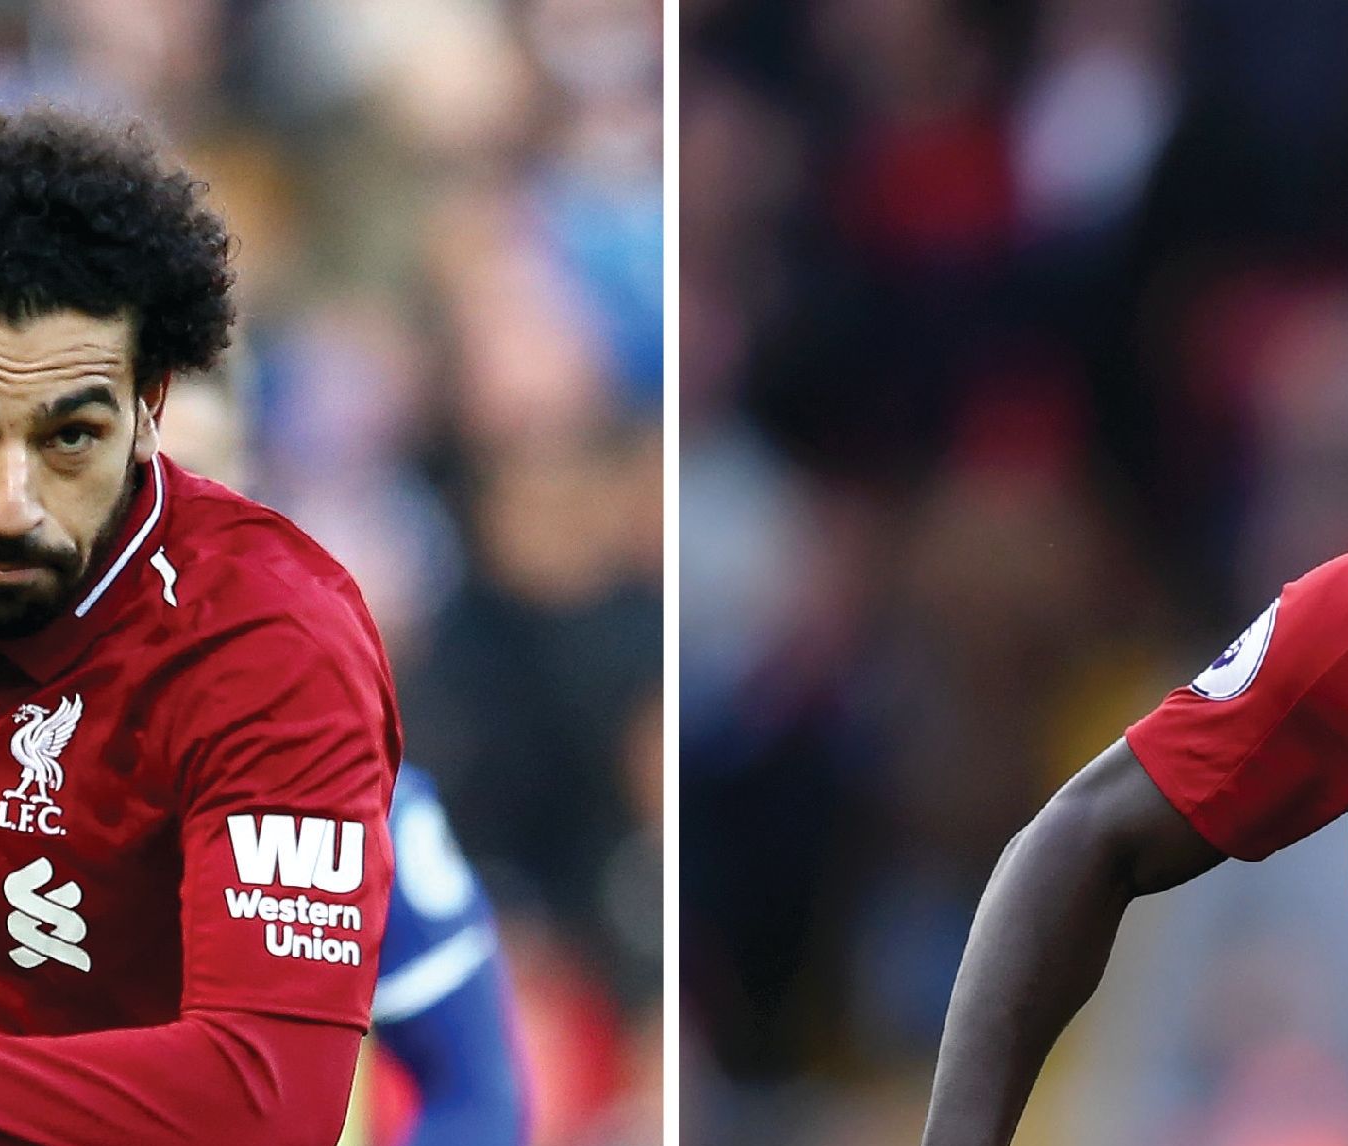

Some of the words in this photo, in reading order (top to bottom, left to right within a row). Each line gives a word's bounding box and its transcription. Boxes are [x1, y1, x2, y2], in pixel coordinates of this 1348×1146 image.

[226, 814, 365, 893] WU
[224, 887, 362, 931] Western
[265, 923, 361, 966] Union
